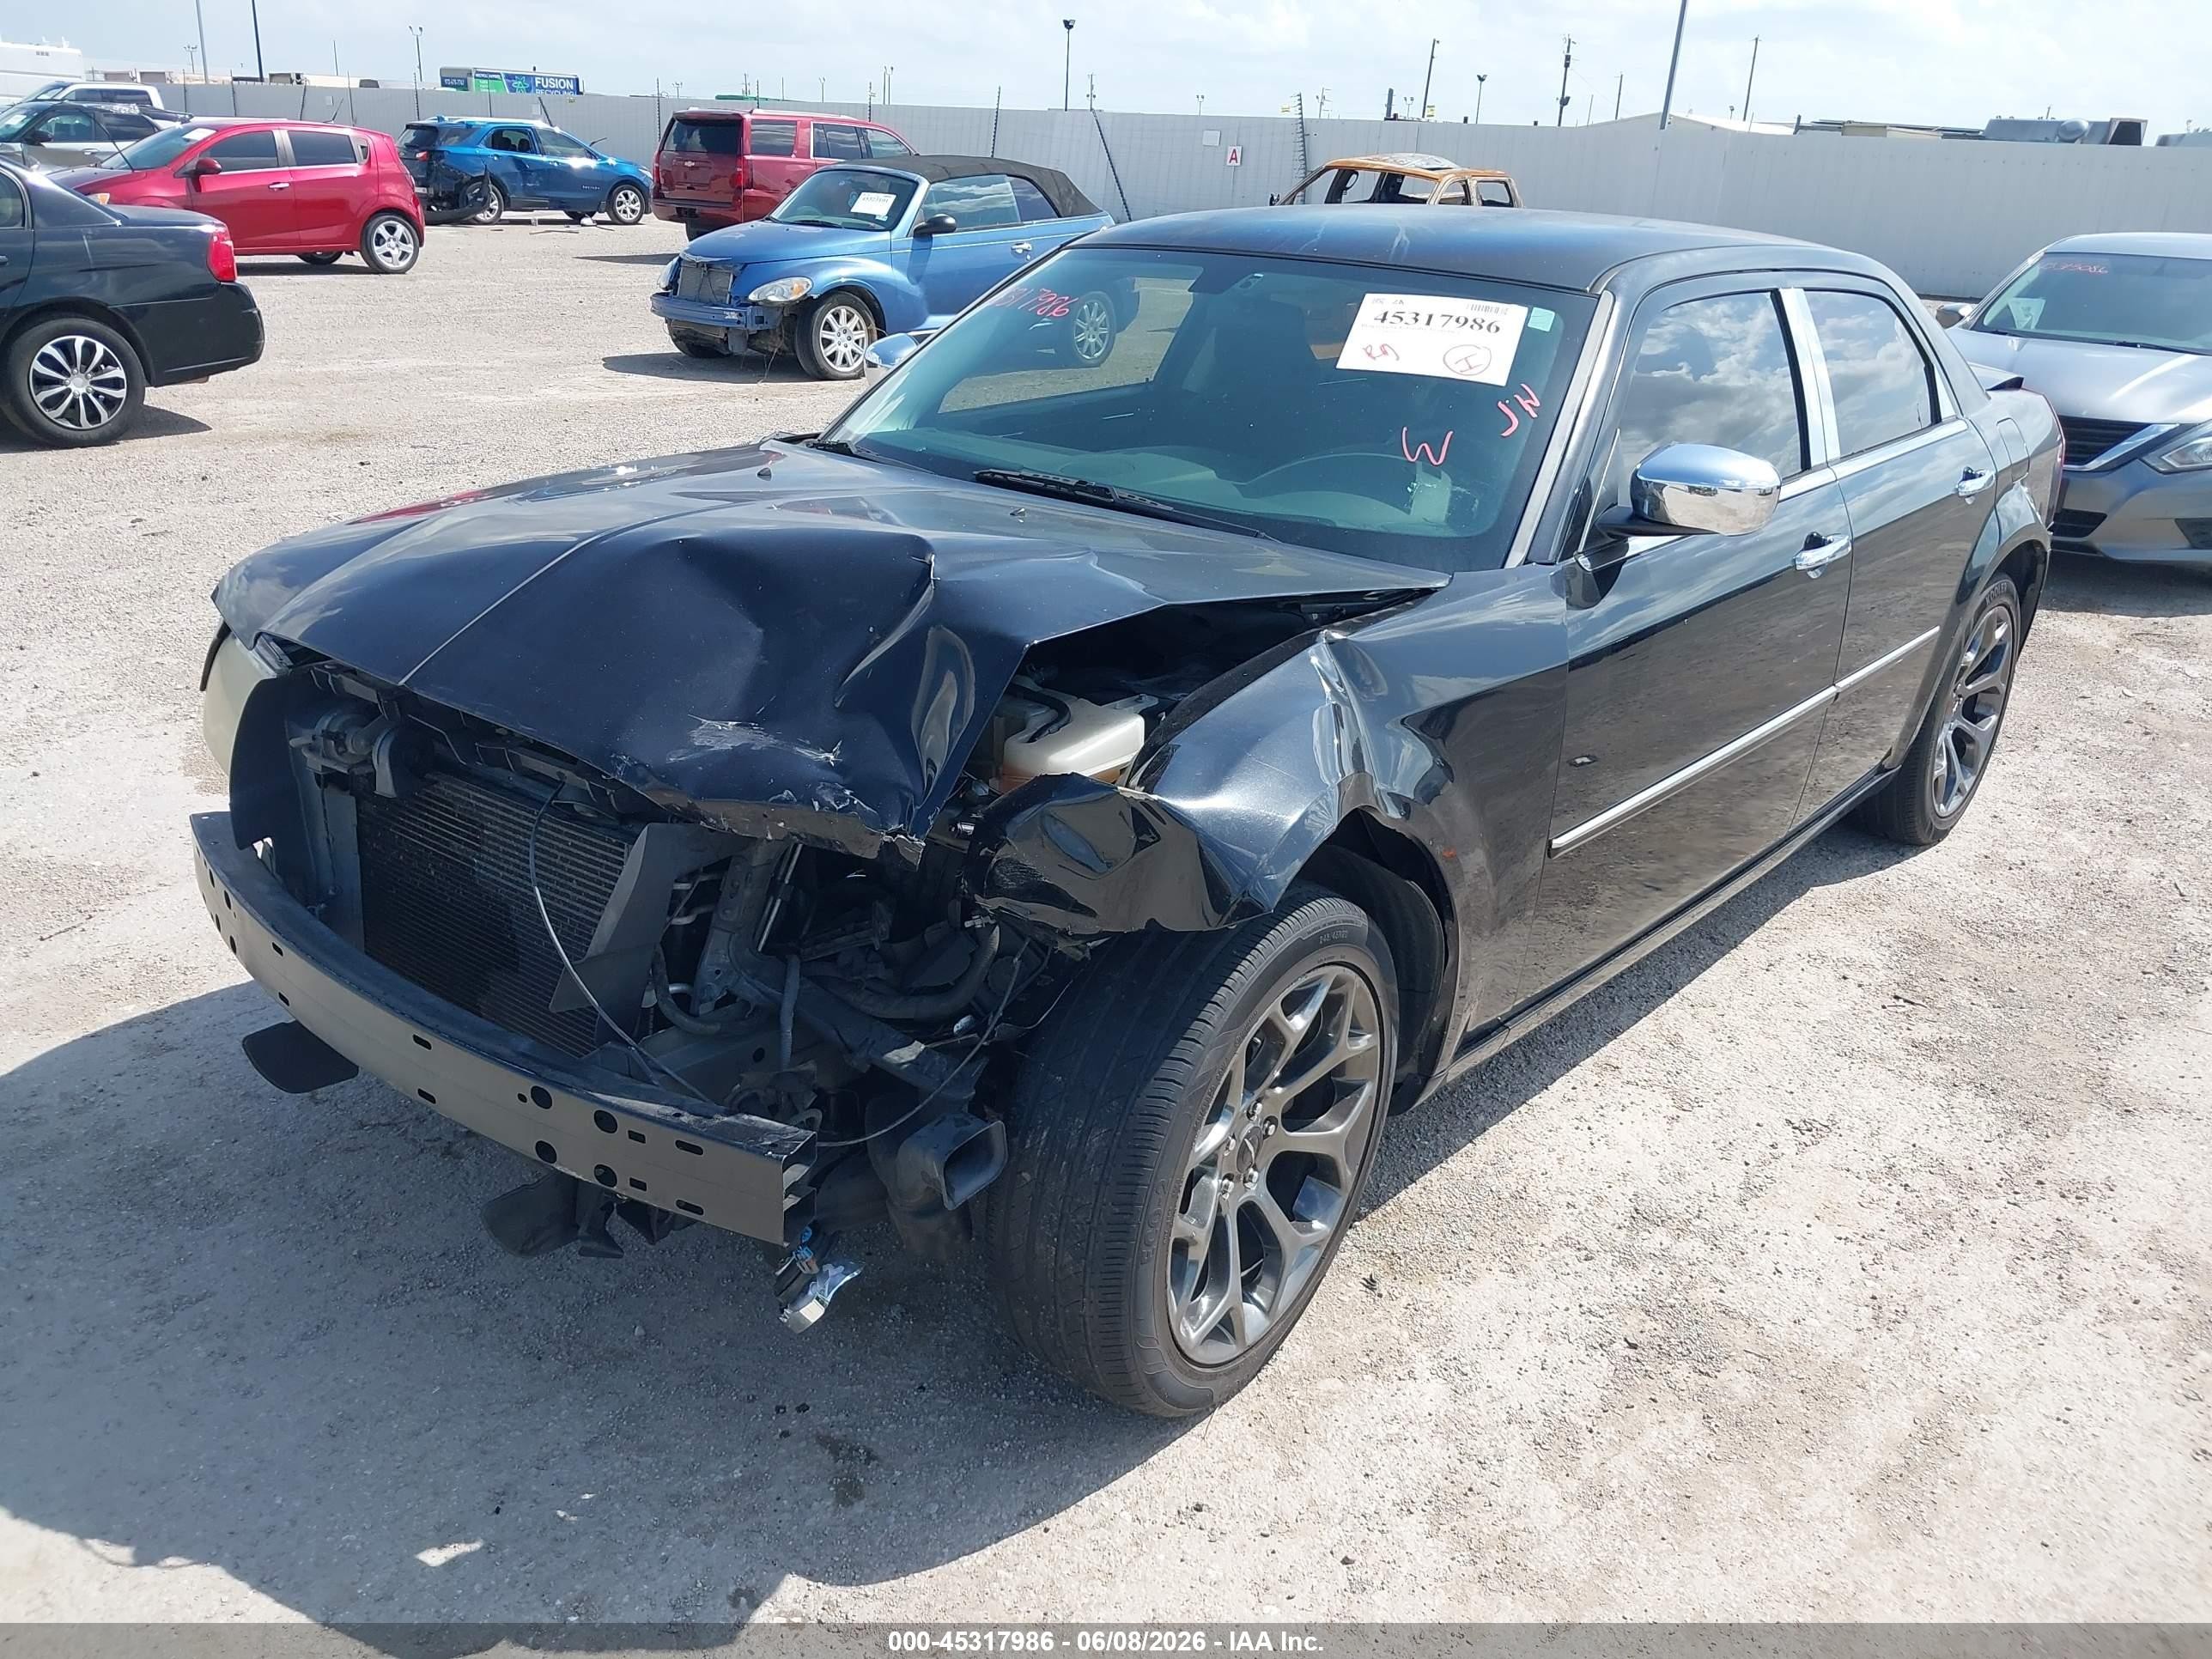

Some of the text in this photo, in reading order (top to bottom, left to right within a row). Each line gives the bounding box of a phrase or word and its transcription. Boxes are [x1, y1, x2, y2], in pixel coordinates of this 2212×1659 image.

[535, 76, 574, 89] FUSION
[1229, 148, 1238, 163] A
[1374, 310, 1501, 334] 45317986
[1401, 426, 1454, 466] W
